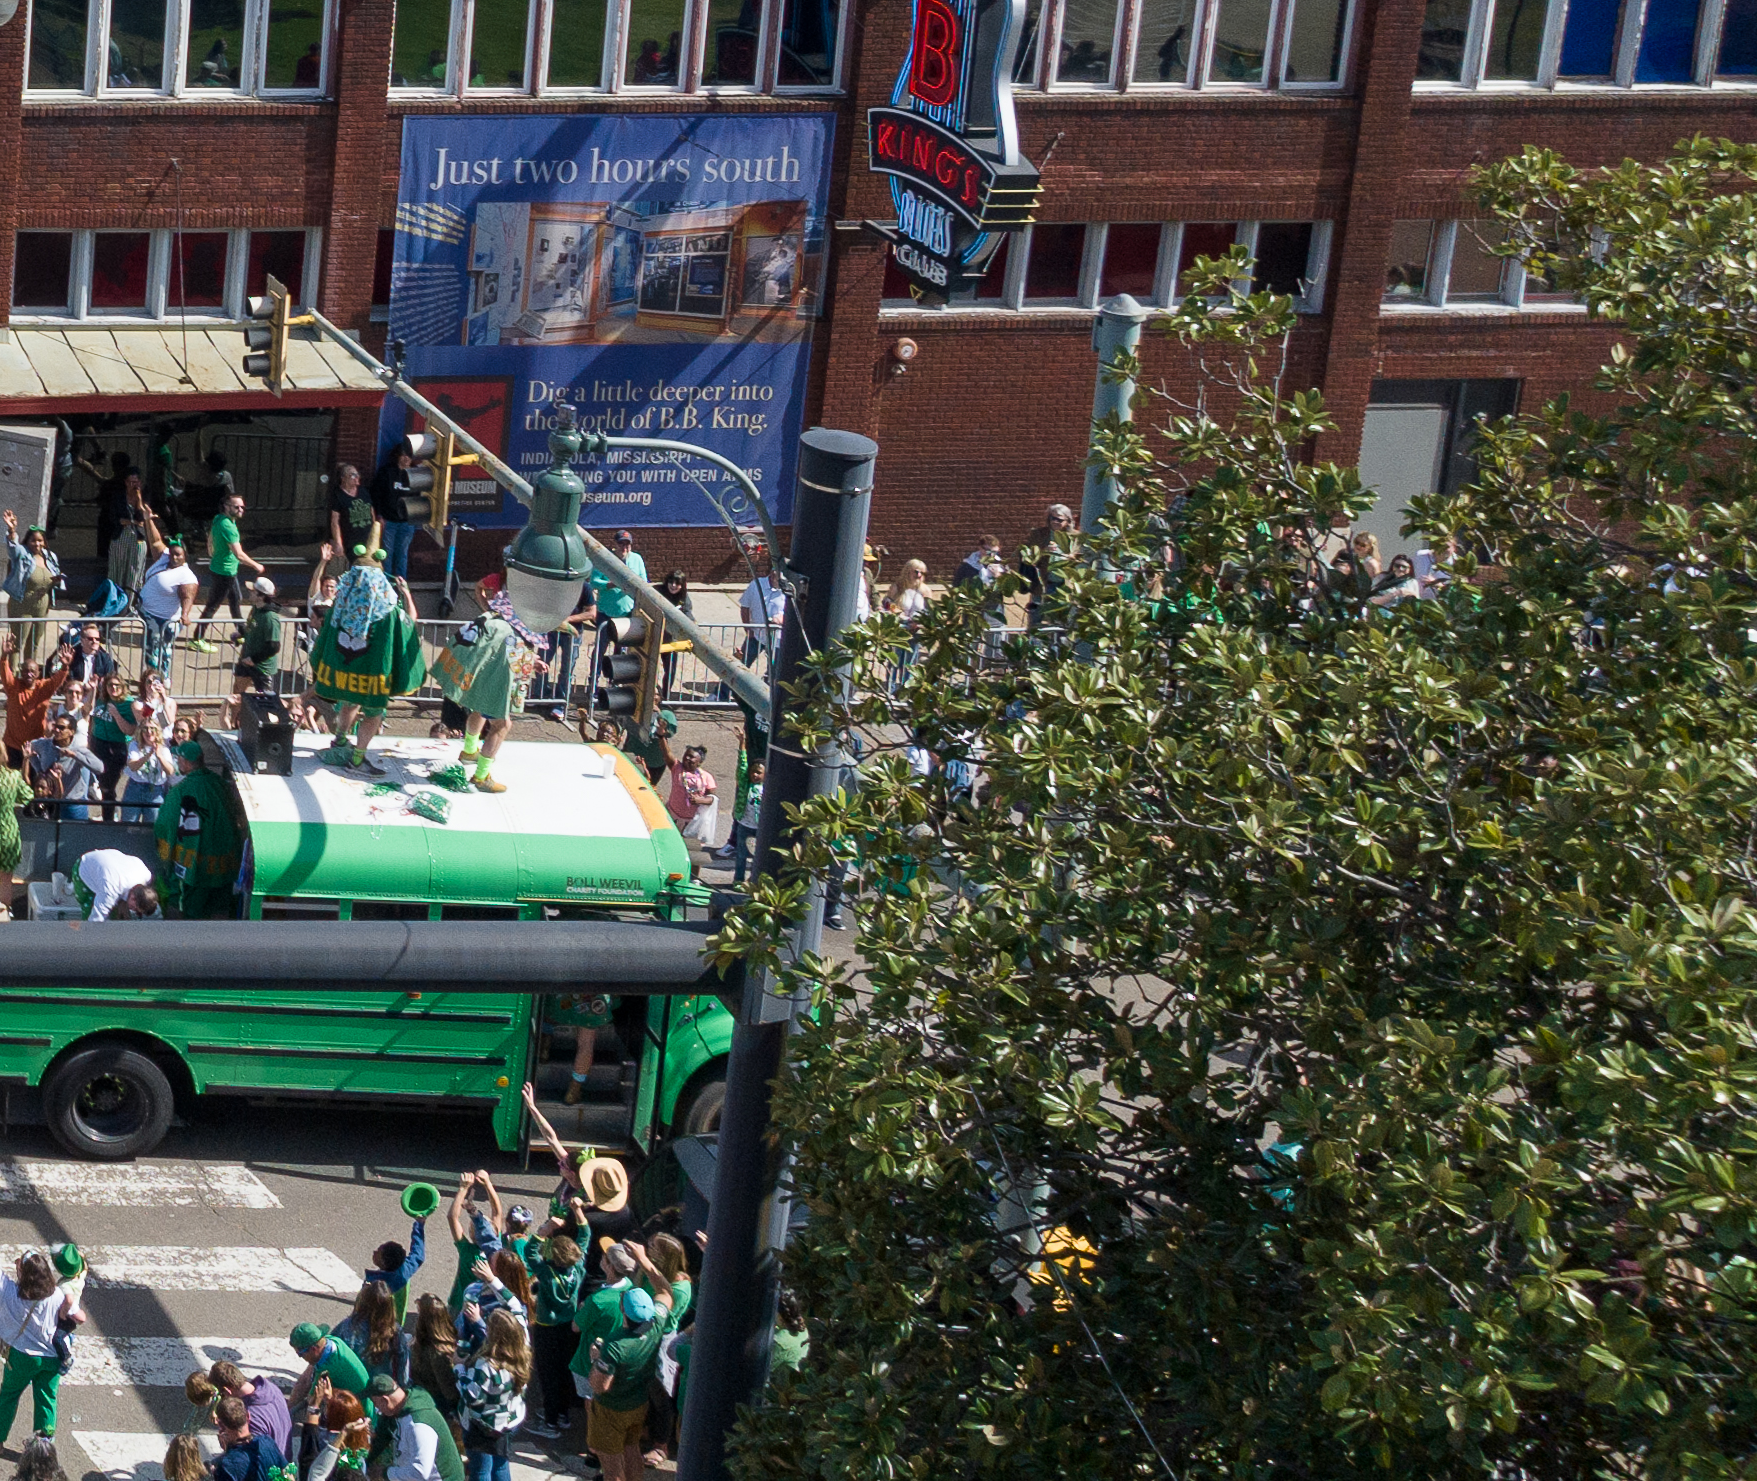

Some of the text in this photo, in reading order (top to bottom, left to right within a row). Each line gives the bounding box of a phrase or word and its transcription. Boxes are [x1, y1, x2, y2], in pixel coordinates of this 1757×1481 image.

[430, 146, 801, 191] Just two hours south
[898, 189, 955, 258] BLUES
[896, 245, 948, 286] CLUB
[527, 379, 774, 409] Dig a little deeper into
[525, 408, 558, 431] the
[630, 405, 652, 429] of
[660, 406, 703, 429] B.B.
[710, 405, 768, 436] King.
[521, 451, 602, 466] INDIAOLA,
[454, 480, 497, 495] MUSEUM
[609, 468, 762, 484] YOU WITH OPEN AMS
[567, 876, 644, 890] BOLL WEEVIL
[598, 888, 644, 896] FOUNDATION
